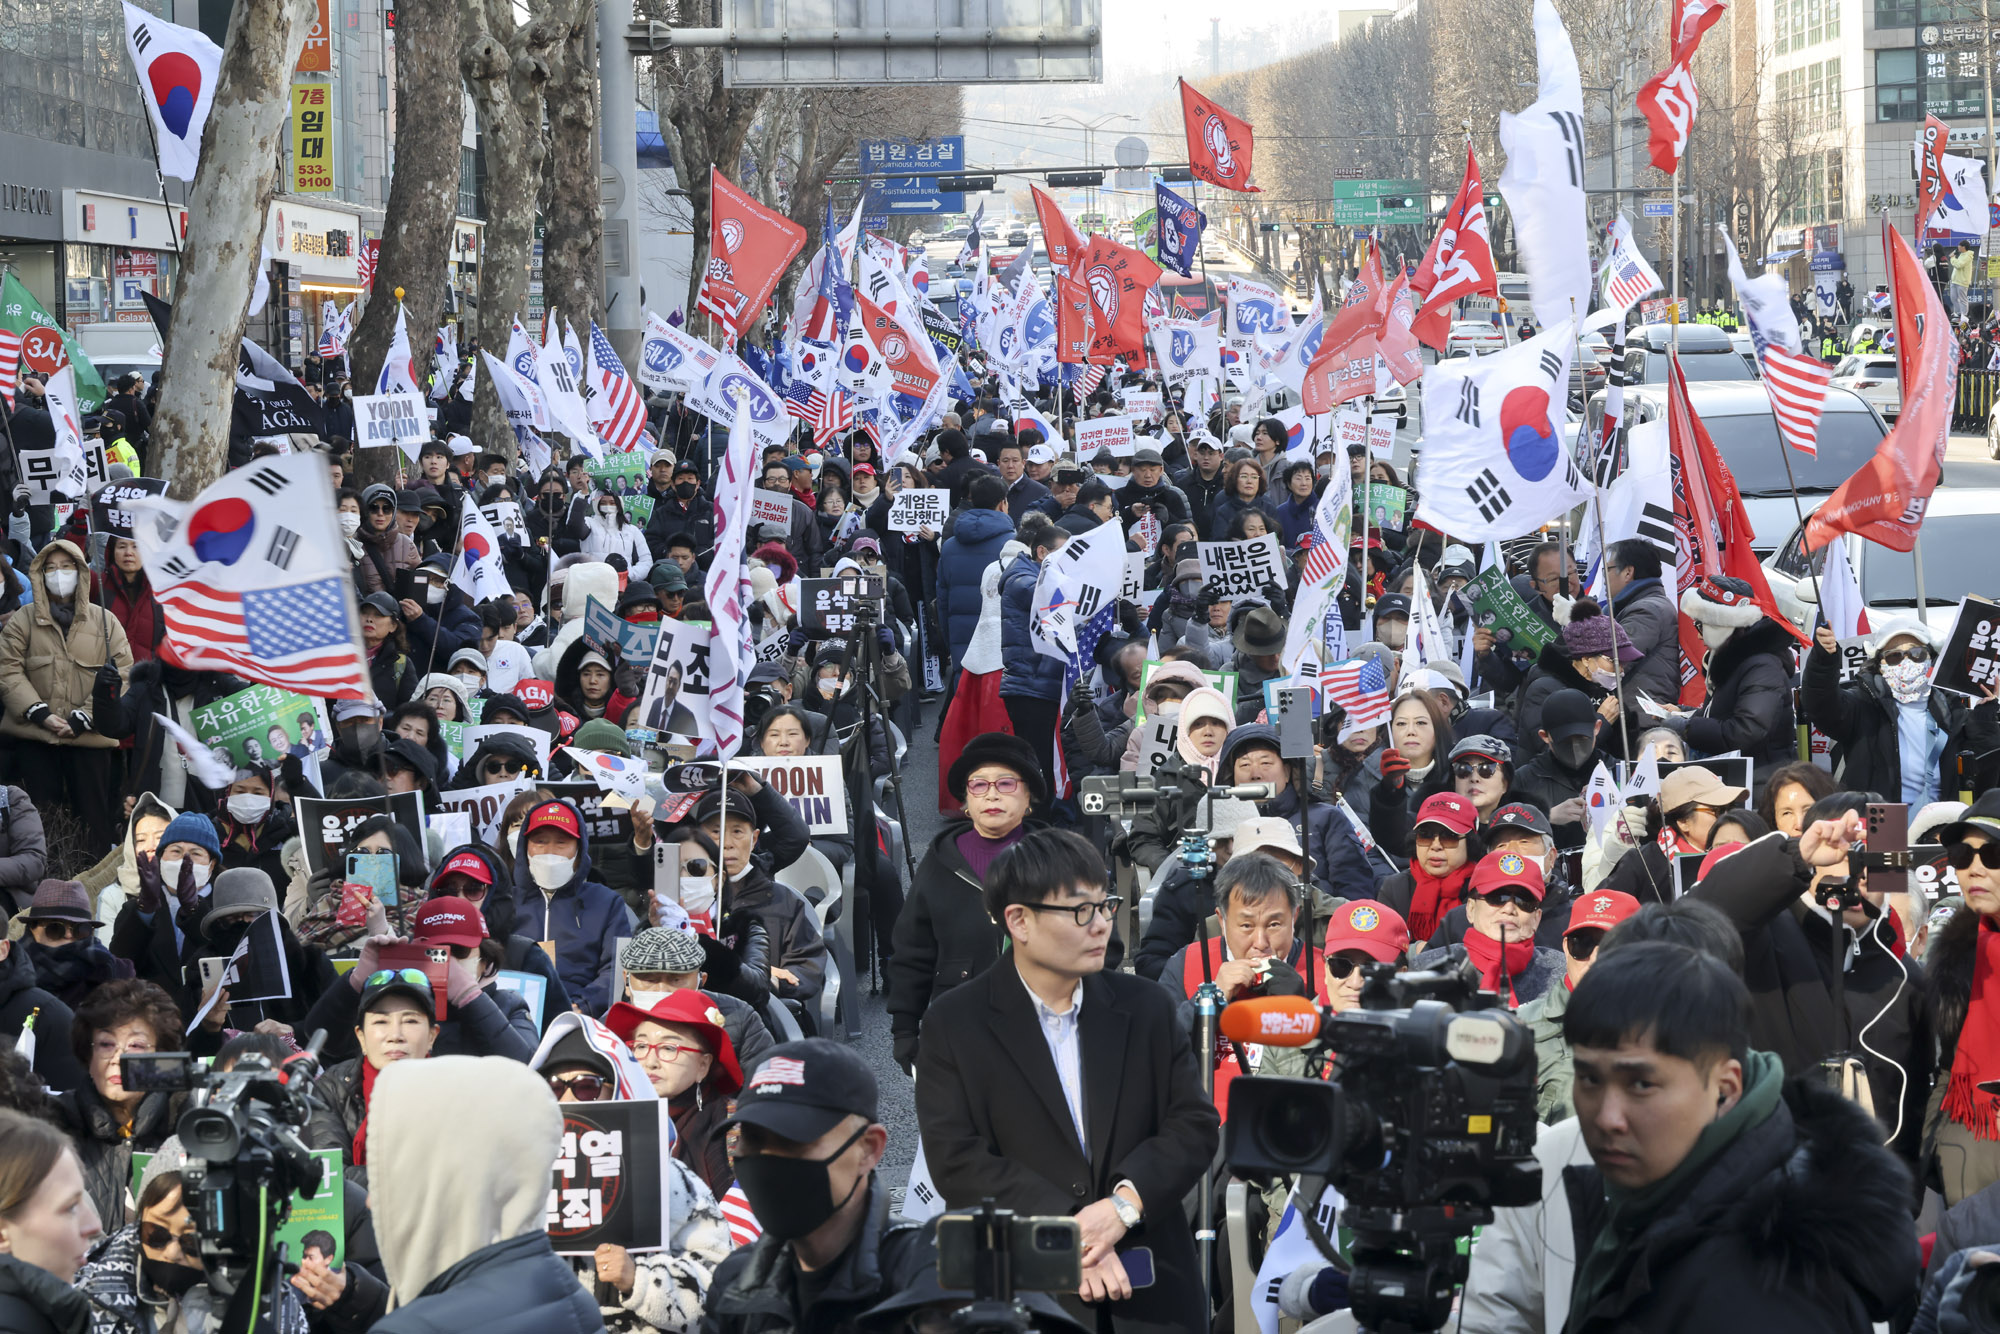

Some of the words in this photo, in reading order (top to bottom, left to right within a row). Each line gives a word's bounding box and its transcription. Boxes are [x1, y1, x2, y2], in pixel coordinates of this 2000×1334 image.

[1927, 53, 1946, 65] 형사
[1928, 67, 1946, 77] 사건
[299, 89, 325, 105] 7층
[301, 111, 325, 159] 임대
[298, 165, 328, 175] 533-
[298, 178, 331, 187] 9100
[118, 313, 149, 324] Galaxy
[891, 368, 931, 391] 패방지대
[366, 399, 415, 421] YOON
[367, 418, 421, 440] AGAIN
[1080, 430, 1104, 441] 지귀연
[1104, 427, 1130, 437] 판사는
[1343, 421, 1367, 433] 지귀연
[1080, 437, 1131, 452] 공소기각하라!
[1342, 431, 1391, 449] 공소기하라!
[764, 503, 788, 513] 판사는
[898, 494, 940, 511] 계엄은
[891, 511, 947, 526] 정당했다
[1205, 541, 1271, 571] 내란은
[1209, 566, 1277, 597] 없었다
[816, 590, 848, 611] 윤석
[584, 633, 606, 657] Free
[537, 815, 570, 825] MARINES
[1489, 805, 1535, 828] SUPERMAN
[461, 859, 480, 869] AGAIN
[1915, 864, 1962, 900] 윤석
[423, 914, 443, 925] COCO
[443, 912, 466, 921] PARK
[1260, 1012, 1316, 1035] 연합뉴스TV
[756, 1083, 783, 1095] Jeep
[552, 1130, 623, 1178] 석열
